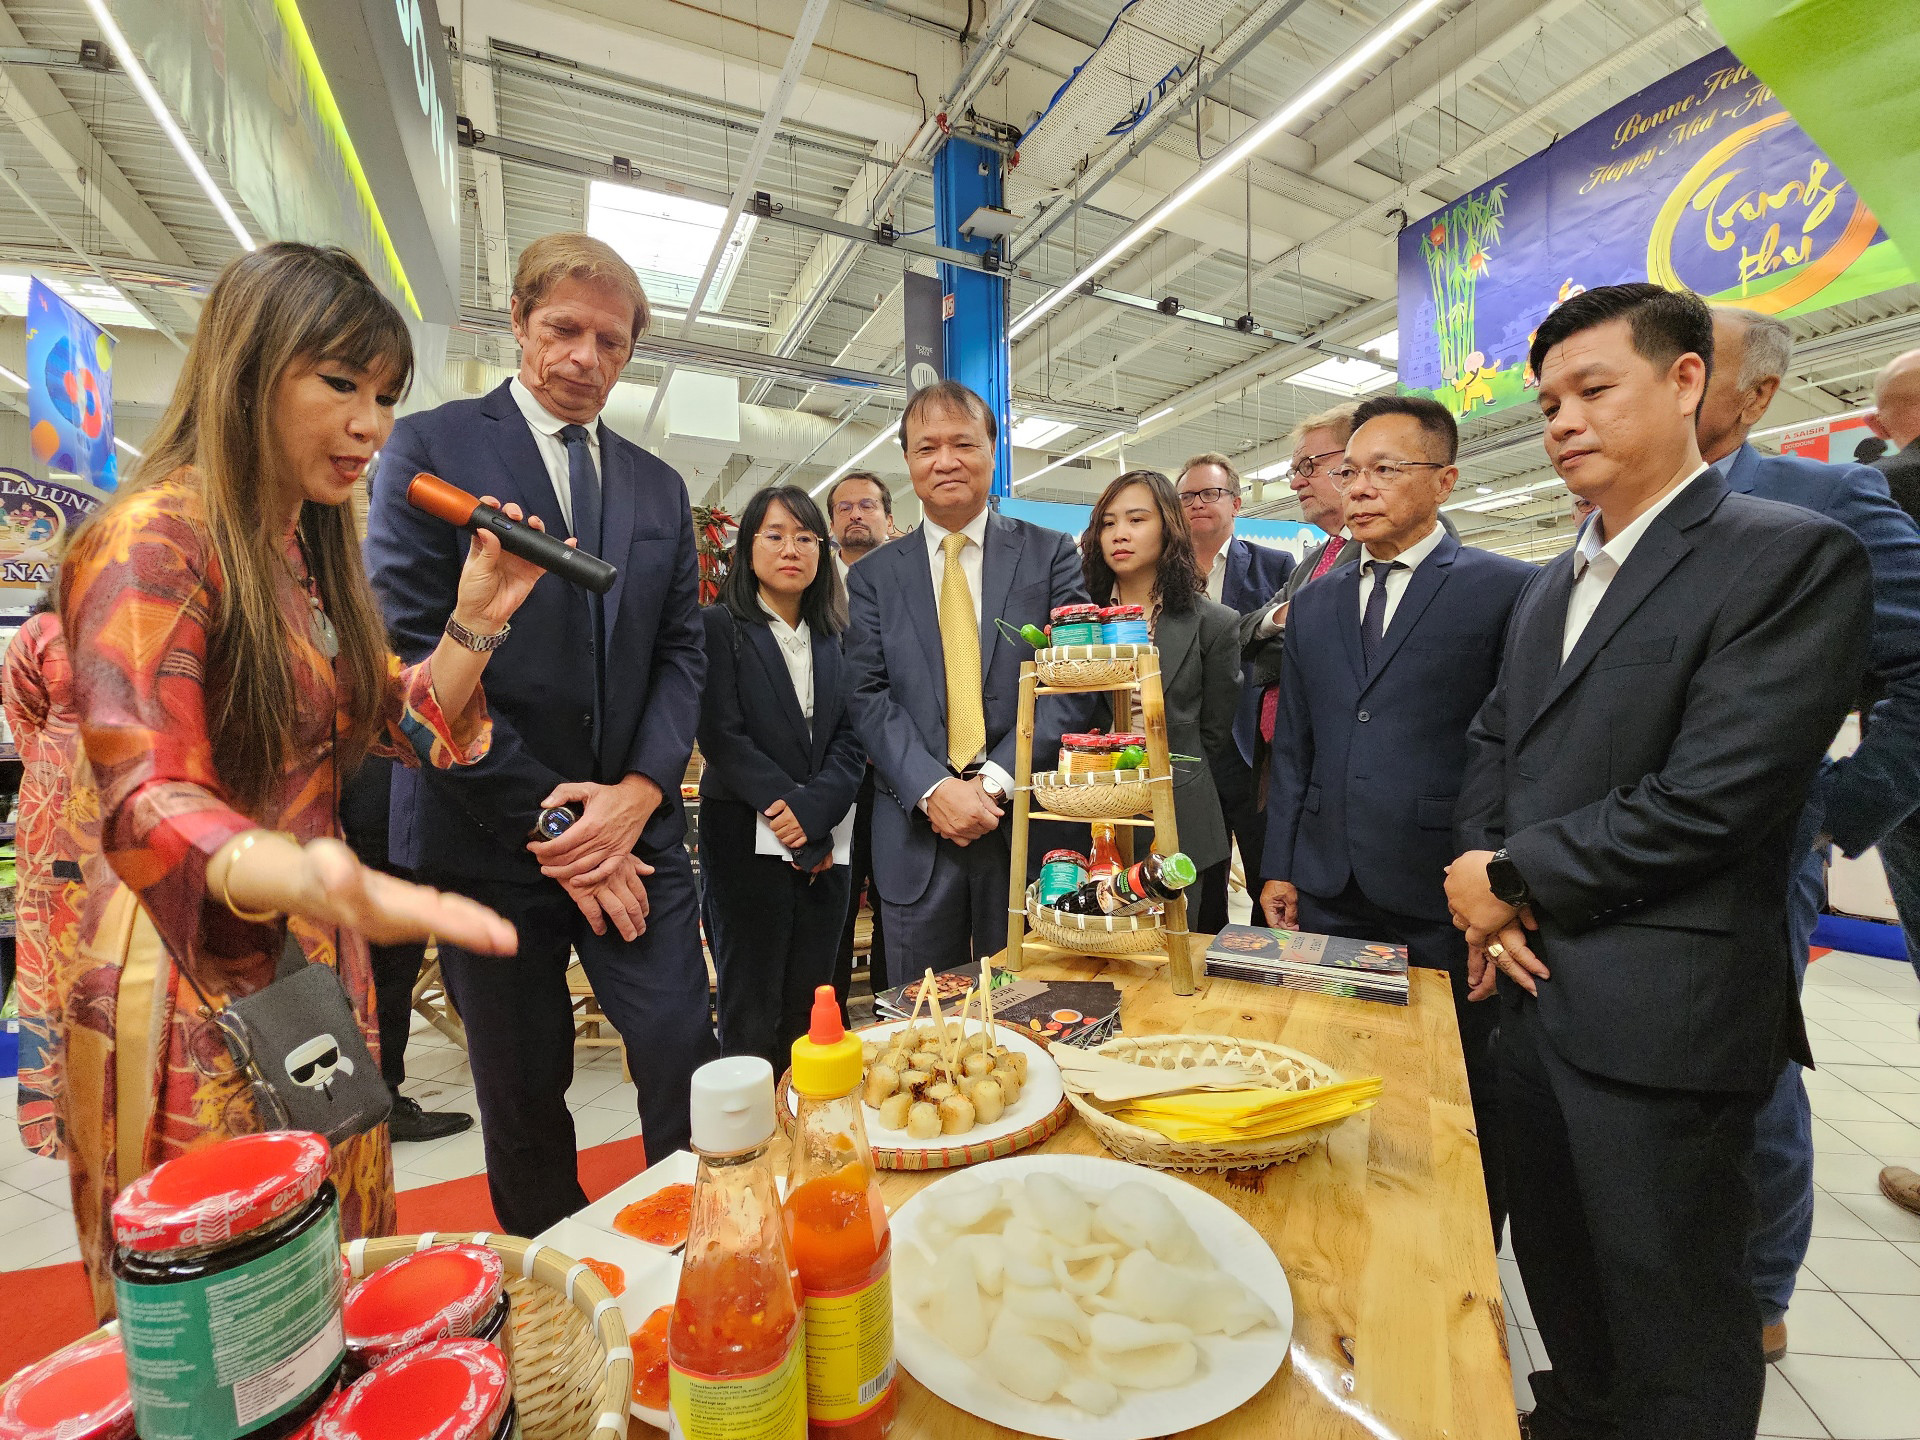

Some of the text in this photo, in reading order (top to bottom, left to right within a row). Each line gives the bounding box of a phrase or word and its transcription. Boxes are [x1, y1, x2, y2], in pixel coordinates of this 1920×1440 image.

[1611, 93, 1696, 150] Bonne
[1579, 145, 1658, 195] Happy
[1793, 427, 1824, 438] SAISIR
[2, 481, 98, 514] LA LUNE
[4, 563, 52, 582] NA
